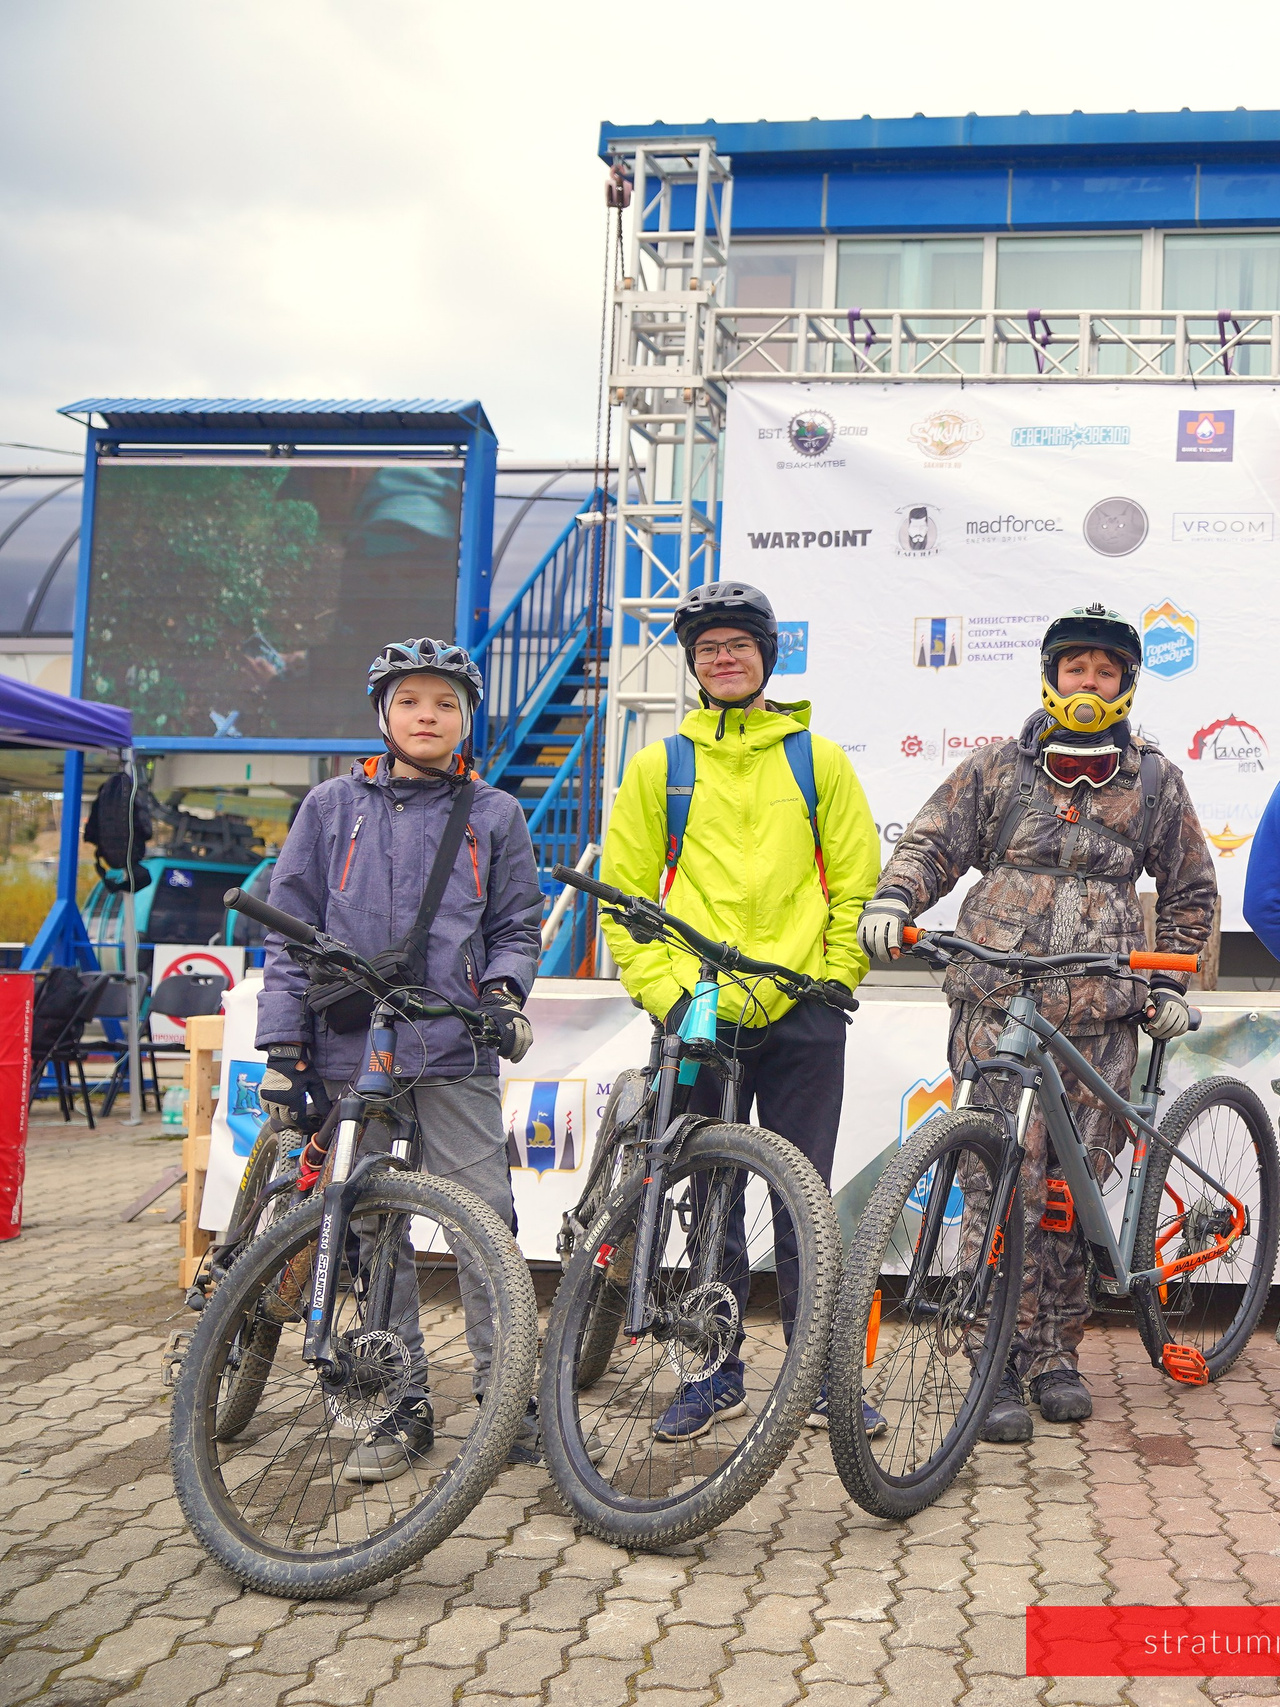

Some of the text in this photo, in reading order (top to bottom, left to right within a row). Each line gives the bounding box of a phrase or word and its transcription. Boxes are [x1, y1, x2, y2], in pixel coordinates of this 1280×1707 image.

[758, 426, 868, 440] EST. 2018
[1011, 426, 1131, 447] СЕВЕРНАЯ ЗВЕЗДА
[776, 459, 846, 470] @SAKHMTBE
[1182, 520, 1265, 533] VROOM
[966, 537, 996, 545] ENERGY
[968, 615, 1050, 625] МИНИСТЕРСТВО
[968, 629, 1008, 637] СПОРТА
[968, 639, 1042, 649] САХАЛИНСКОЙ
[968, 653, 1014, 662] ОБЛАСТИ
[240, 1138, 263, 1191] MAXXIS
[321, 1214, 332, 1250] XCM30
[1172, 1247, 1226, 1274] AVALANCHE
